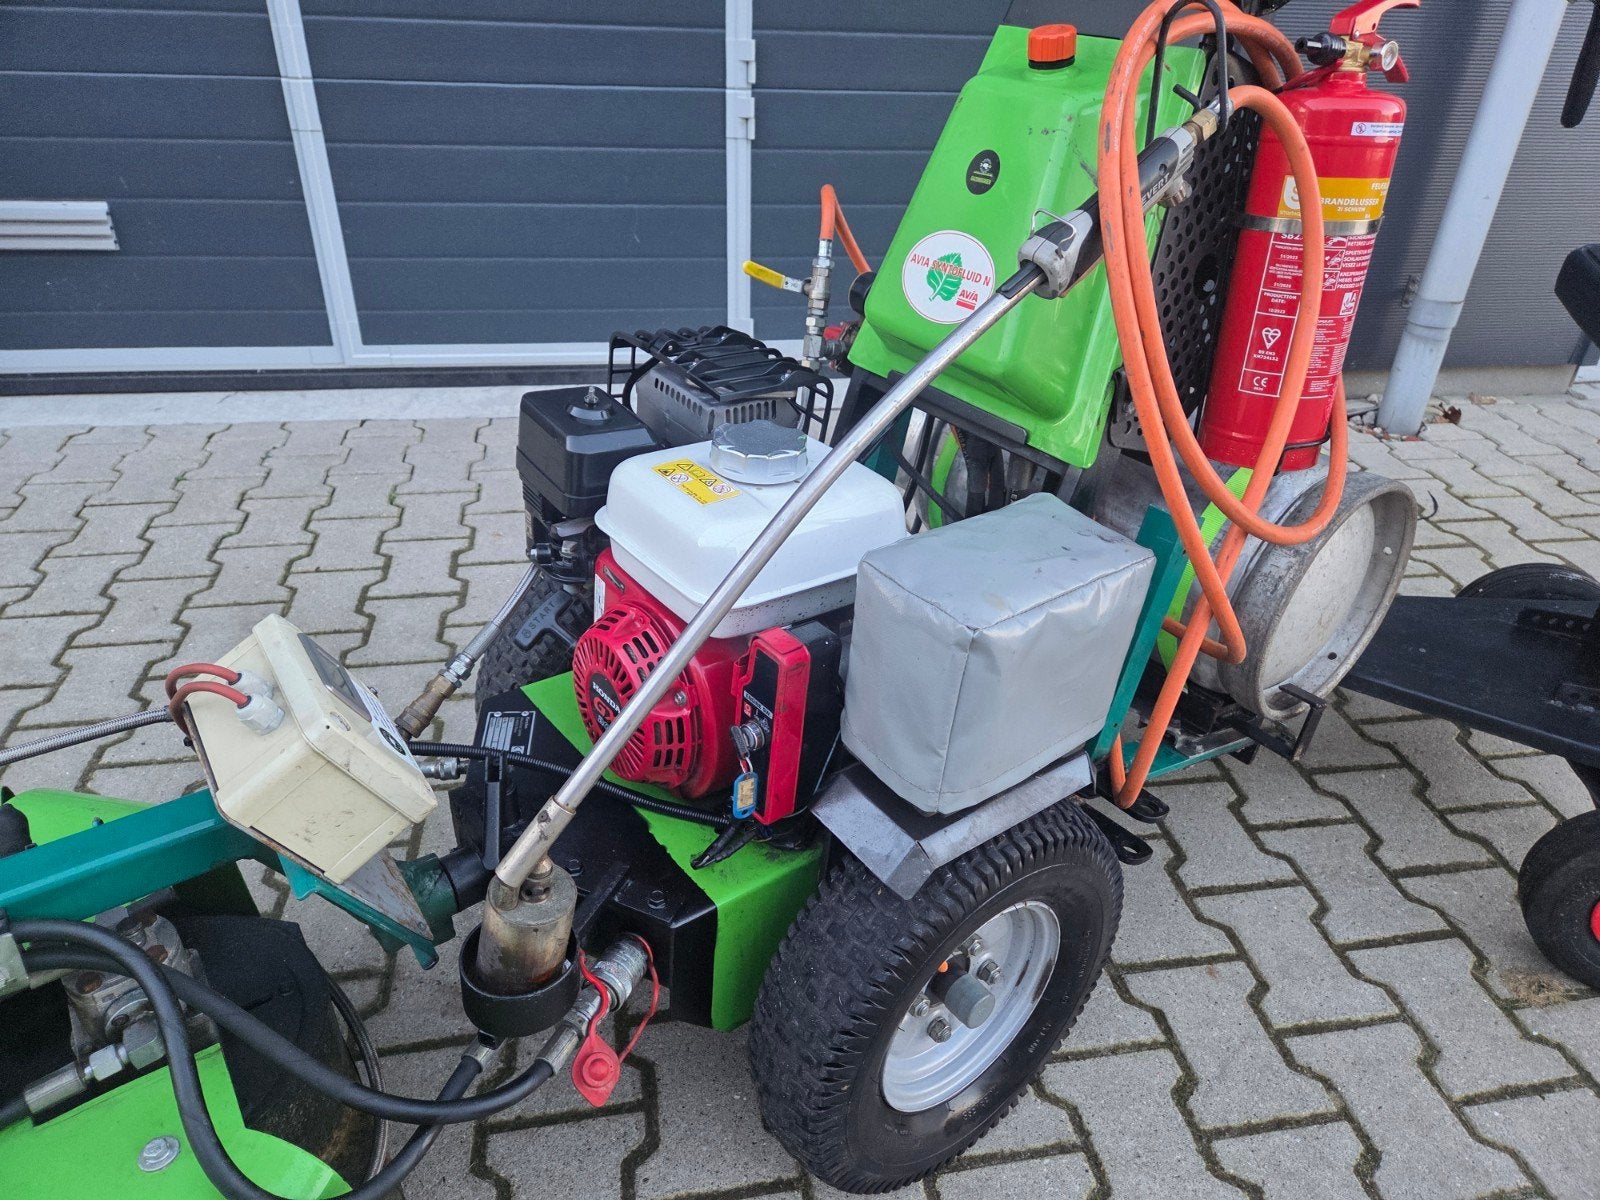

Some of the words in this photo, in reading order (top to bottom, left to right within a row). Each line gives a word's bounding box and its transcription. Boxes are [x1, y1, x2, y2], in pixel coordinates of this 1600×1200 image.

[1141, 172, 1170, 206] EVERT
[911, 253, 930, 268] AVIA
[983, 275, 992, 287] N
[1263, 292, 1297, 300] PRODUCTION
[1253, 376, 1268, 387] CE
[528, 601, 556, 630] START
